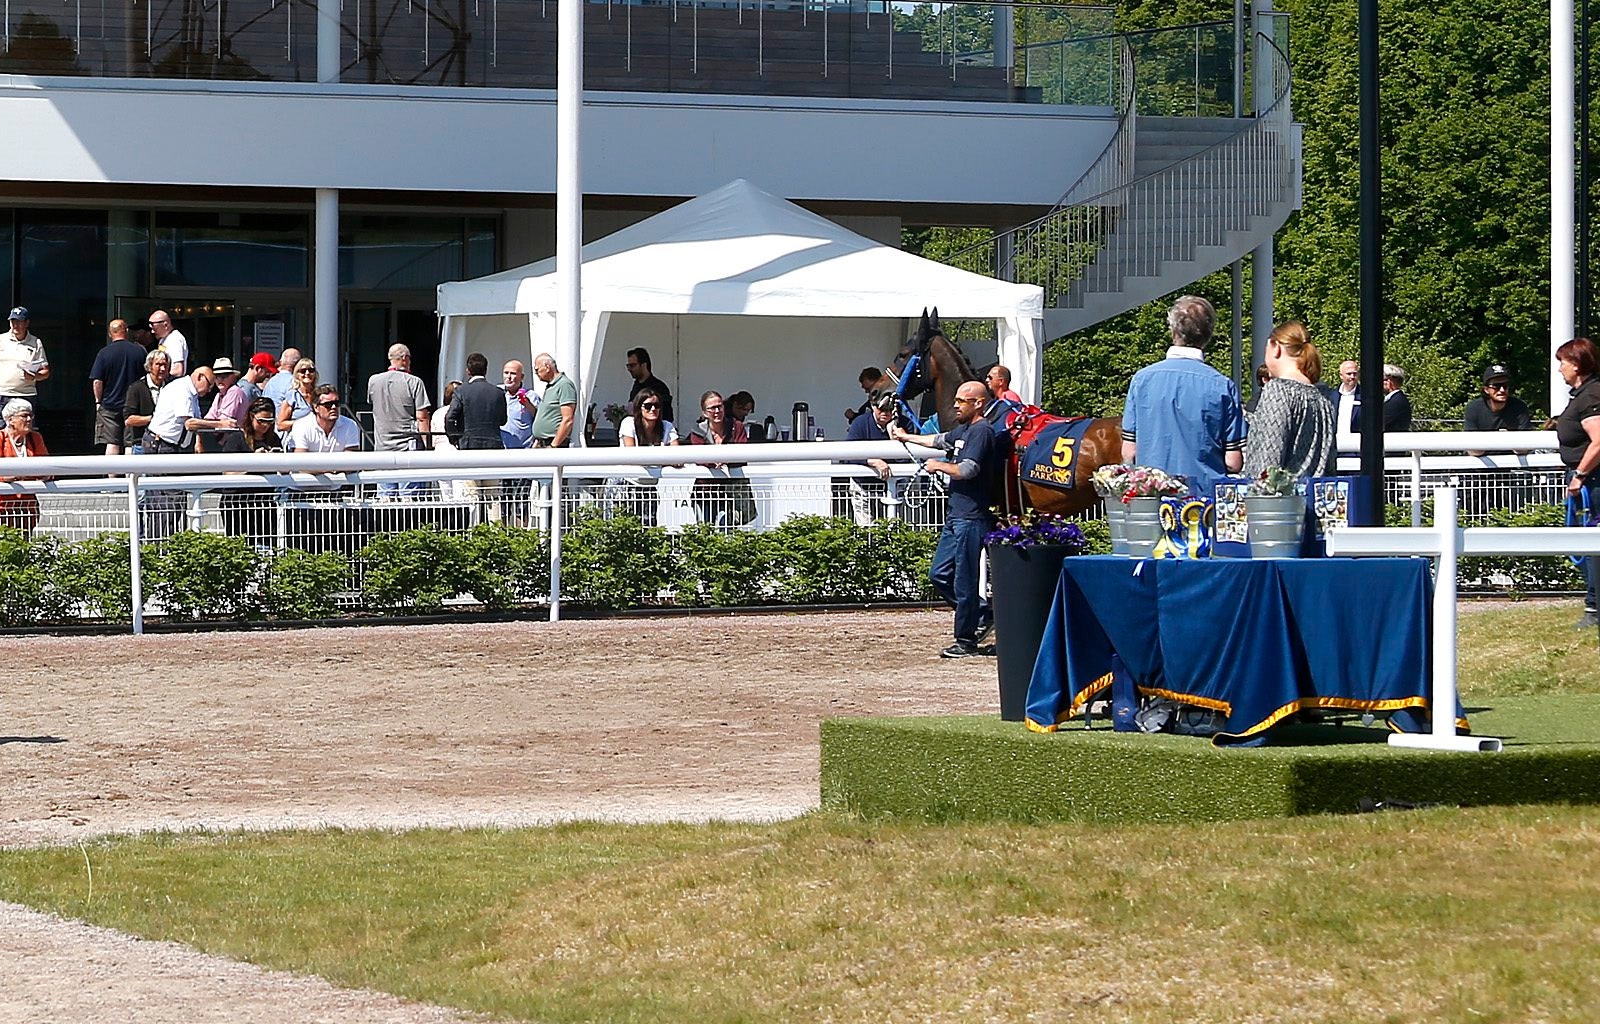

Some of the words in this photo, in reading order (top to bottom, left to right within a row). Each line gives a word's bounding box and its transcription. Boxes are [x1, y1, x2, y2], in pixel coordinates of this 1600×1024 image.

[1051, 436, 1075, 468] 5
[1035, 464, 1053, 473] BRO
[1030, 470, 1052, 481] PARK
